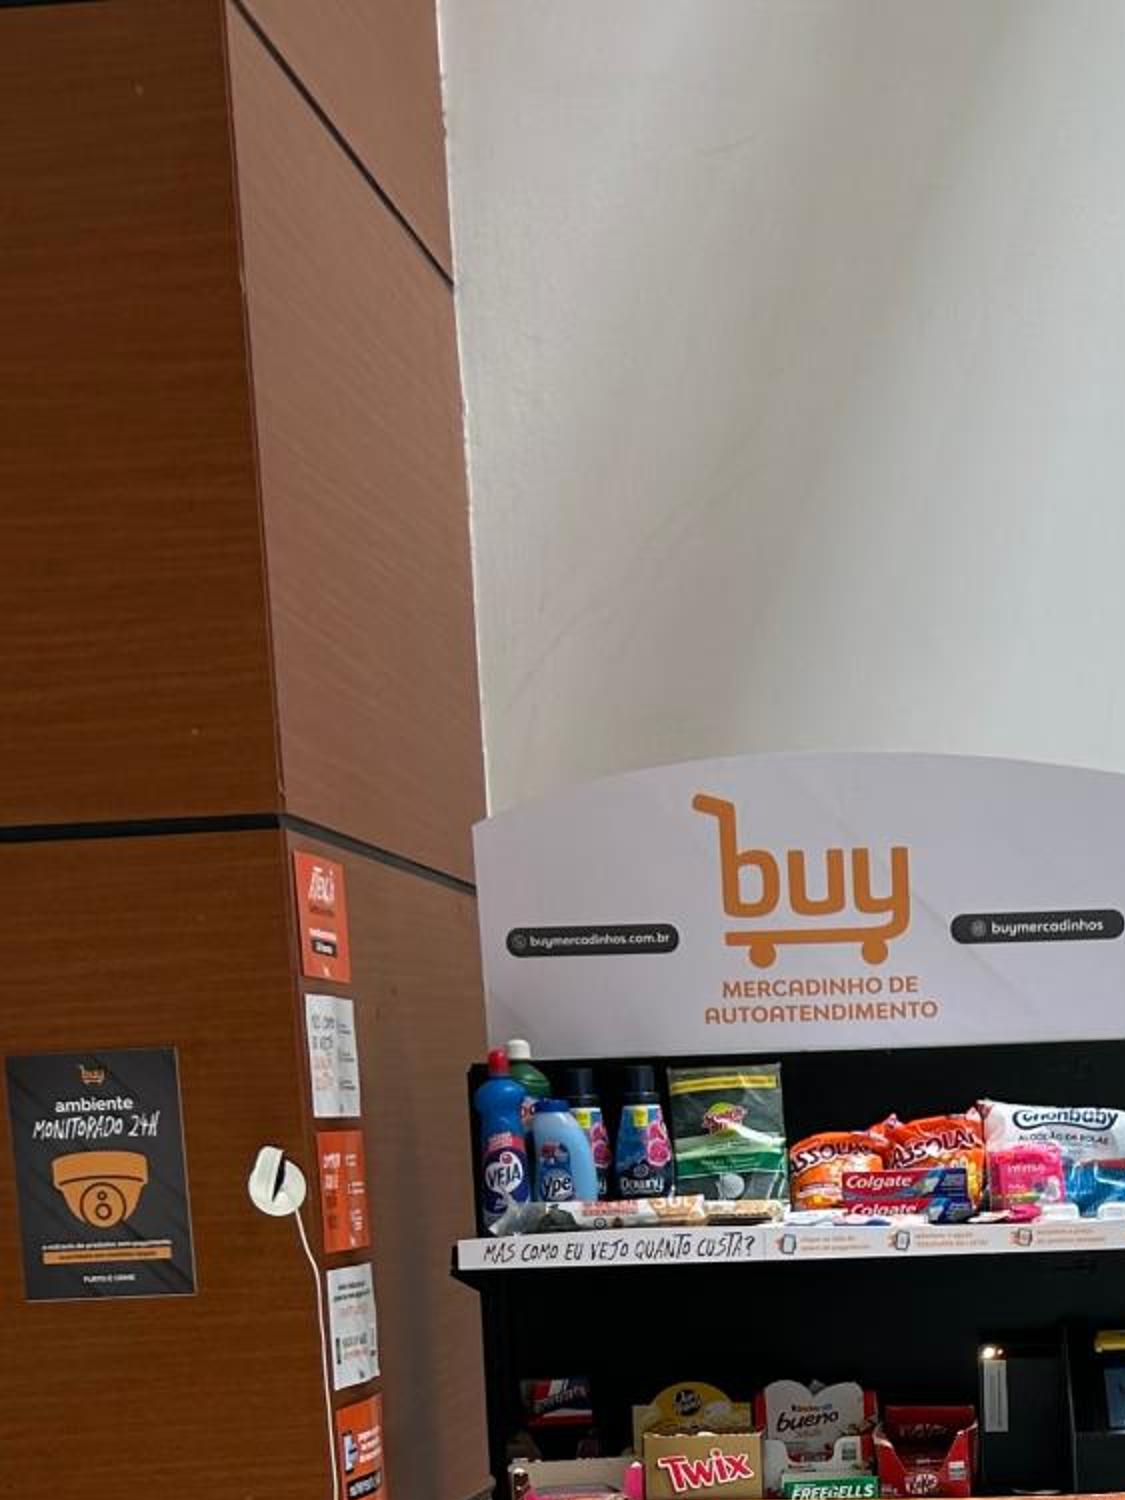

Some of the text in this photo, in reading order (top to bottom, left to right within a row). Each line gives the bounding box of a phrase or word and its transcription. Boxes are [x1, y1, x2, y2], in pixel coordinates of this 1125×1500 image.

[692, 793, 911, 946] buy
[530, 928, 671, 950] buymercadinhos.com.br
[991, 917, 1104, 937] buymercadinhos
[722, 975, 919, 1000] MERCADINHO DE
[704, 1000, 938, 1025] AUTOATENDIMENTO
[55, 1095, 134, 1113] ambiente
[32, 1110, 160, 1140] MONITORADO 24H
[846, 1174, 913, 1190] Colgate
[851, 1203, 918, 1216] Colgate
[483, 1231, 757, 1265] MAS COMO EU VEJO QUANTO CUSTA?
[776, 1410, 839, 1433] bueno
[658, 1447, 755, 1493] Twix
